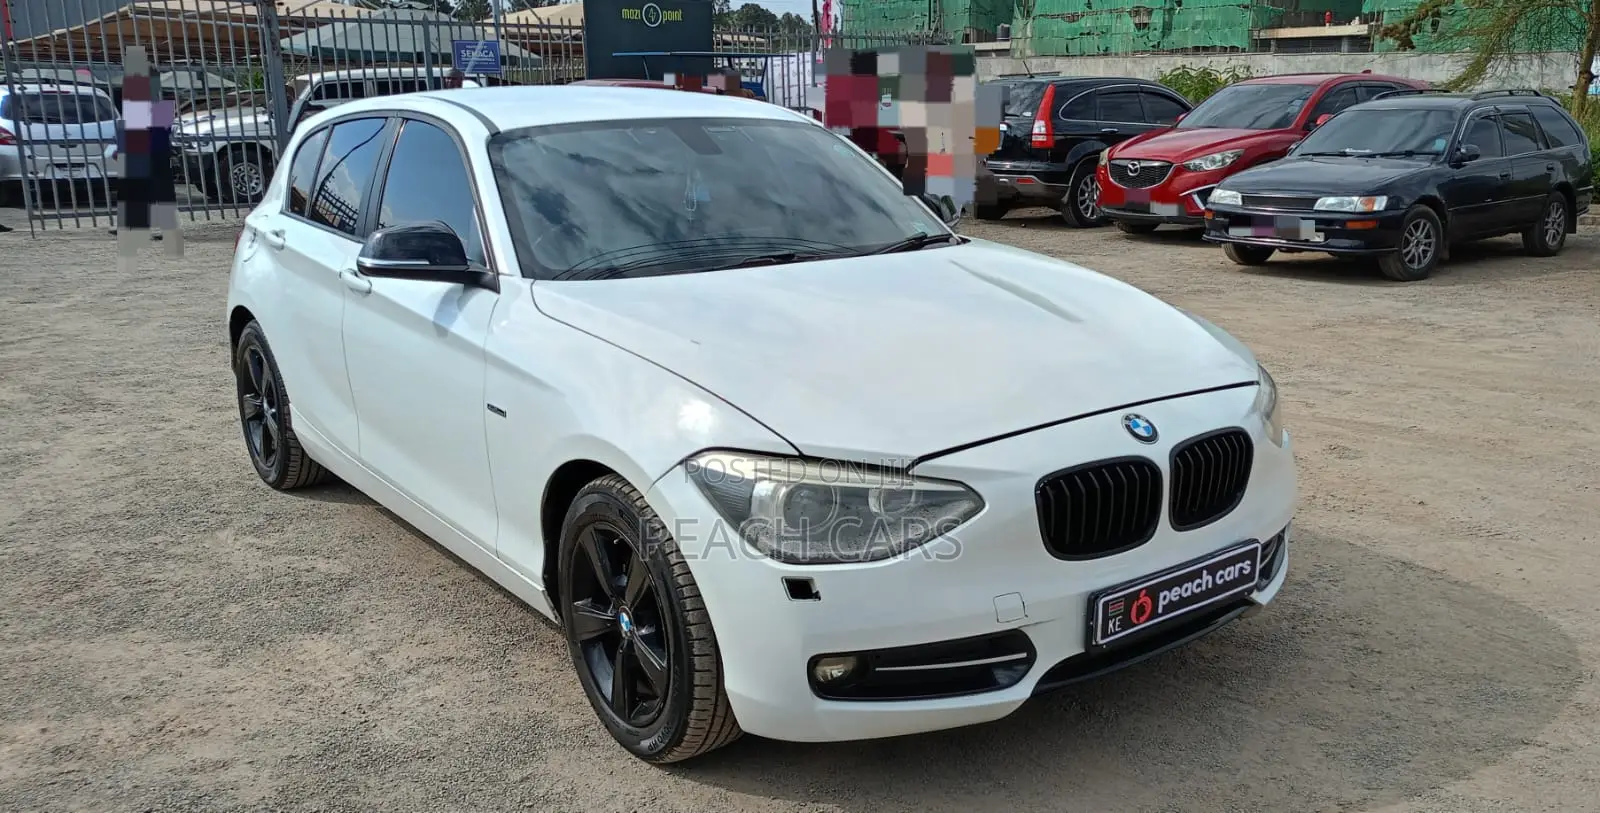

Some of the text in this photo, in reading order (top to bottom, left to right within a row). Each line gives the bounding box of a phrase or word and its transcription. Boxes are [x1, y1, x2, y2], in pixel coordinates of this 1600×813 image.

[663, 9, 683, 24] point
[1158, 560, 1252, 613] peach cars
[1108, 615, 1122, 635] KE
